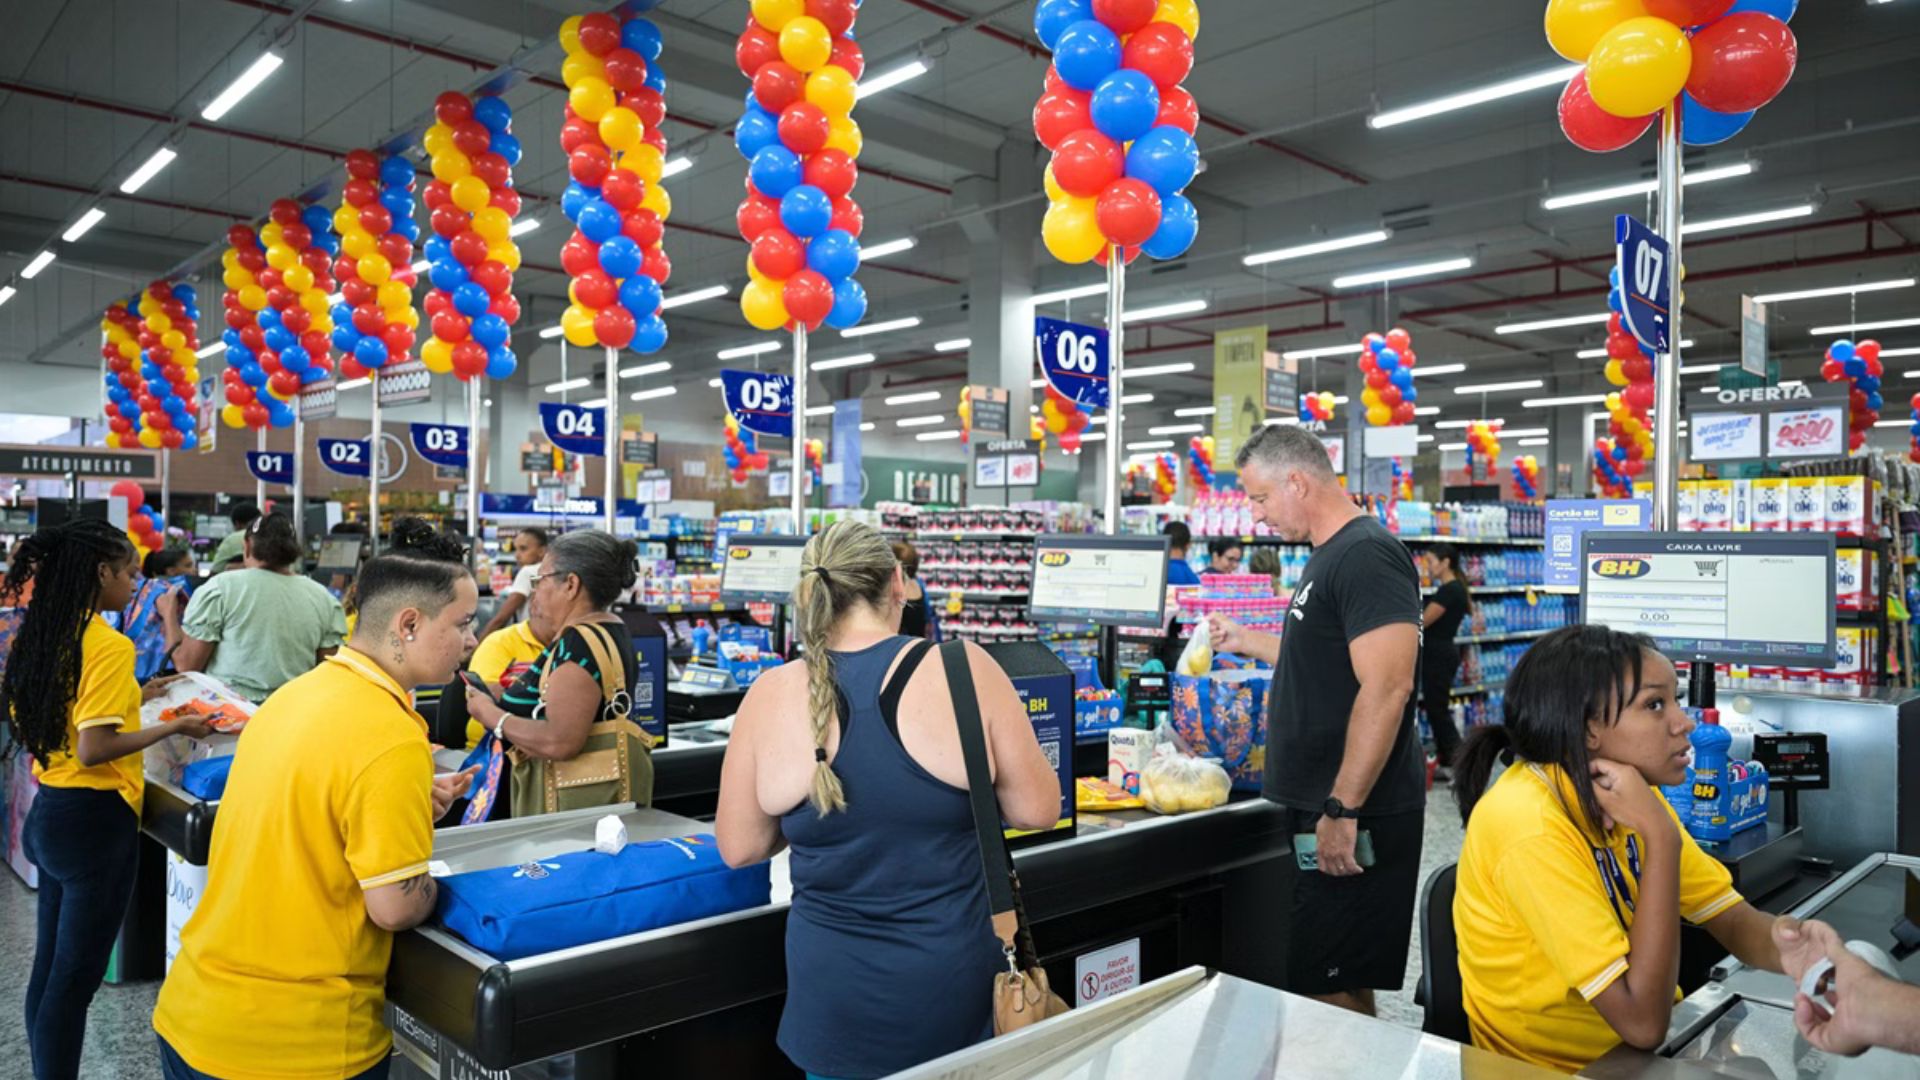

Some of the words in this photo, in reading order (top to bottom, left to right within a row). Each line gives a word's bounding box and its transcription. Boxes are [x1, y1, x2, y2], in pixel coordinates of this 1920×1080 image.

[1635, 239, 1663, 302] 07
[1056, 330, 1098, 374] 06
[740, 378, 782, 411] 05
[1717, 384, 1812, 404] OFERTA
[556, 408, 596, 437] 04
[425, 428, 459, 451] 03
[987, 440, 1026, 452] OFERTA
[330, 442, 361, 463] 02
[21, 456, 132, 474] ATENDIMENTO
[257, 454, 283, 473] 01
[1548, 509, 1581, 517] Cartão
[1584, 509, 1599, 517] BH
[1703, 501, 1726, 515] OMO
[1757, 501, 1781, 514] OMO
[1794, 500, 1818, 514] OMO
[1831, 499, 1856, 514] OMO
[1666, 543, 1702, 552] CAIXA
[1706, 543, 1741, 551] LIVRE
[1042, 552, 1066, 564] BH
[1598, 560, 1641, 576] BH
[1838, 574, 1855, 585] MO
[1640, 611, 1670, 622] 0,00
[1837, 653, 1854, 665] MO
[1029, 697, 1049, 712] BH
[1693, 783, 1716, 798] BH
[168, 861, 194, 910] Dove
[1106, 956, 1129, 970] FAVOR
[1100, 964, 1136, 983] DIRIGIR-SE
[1110, 975, 1134, 990] OUTRO
